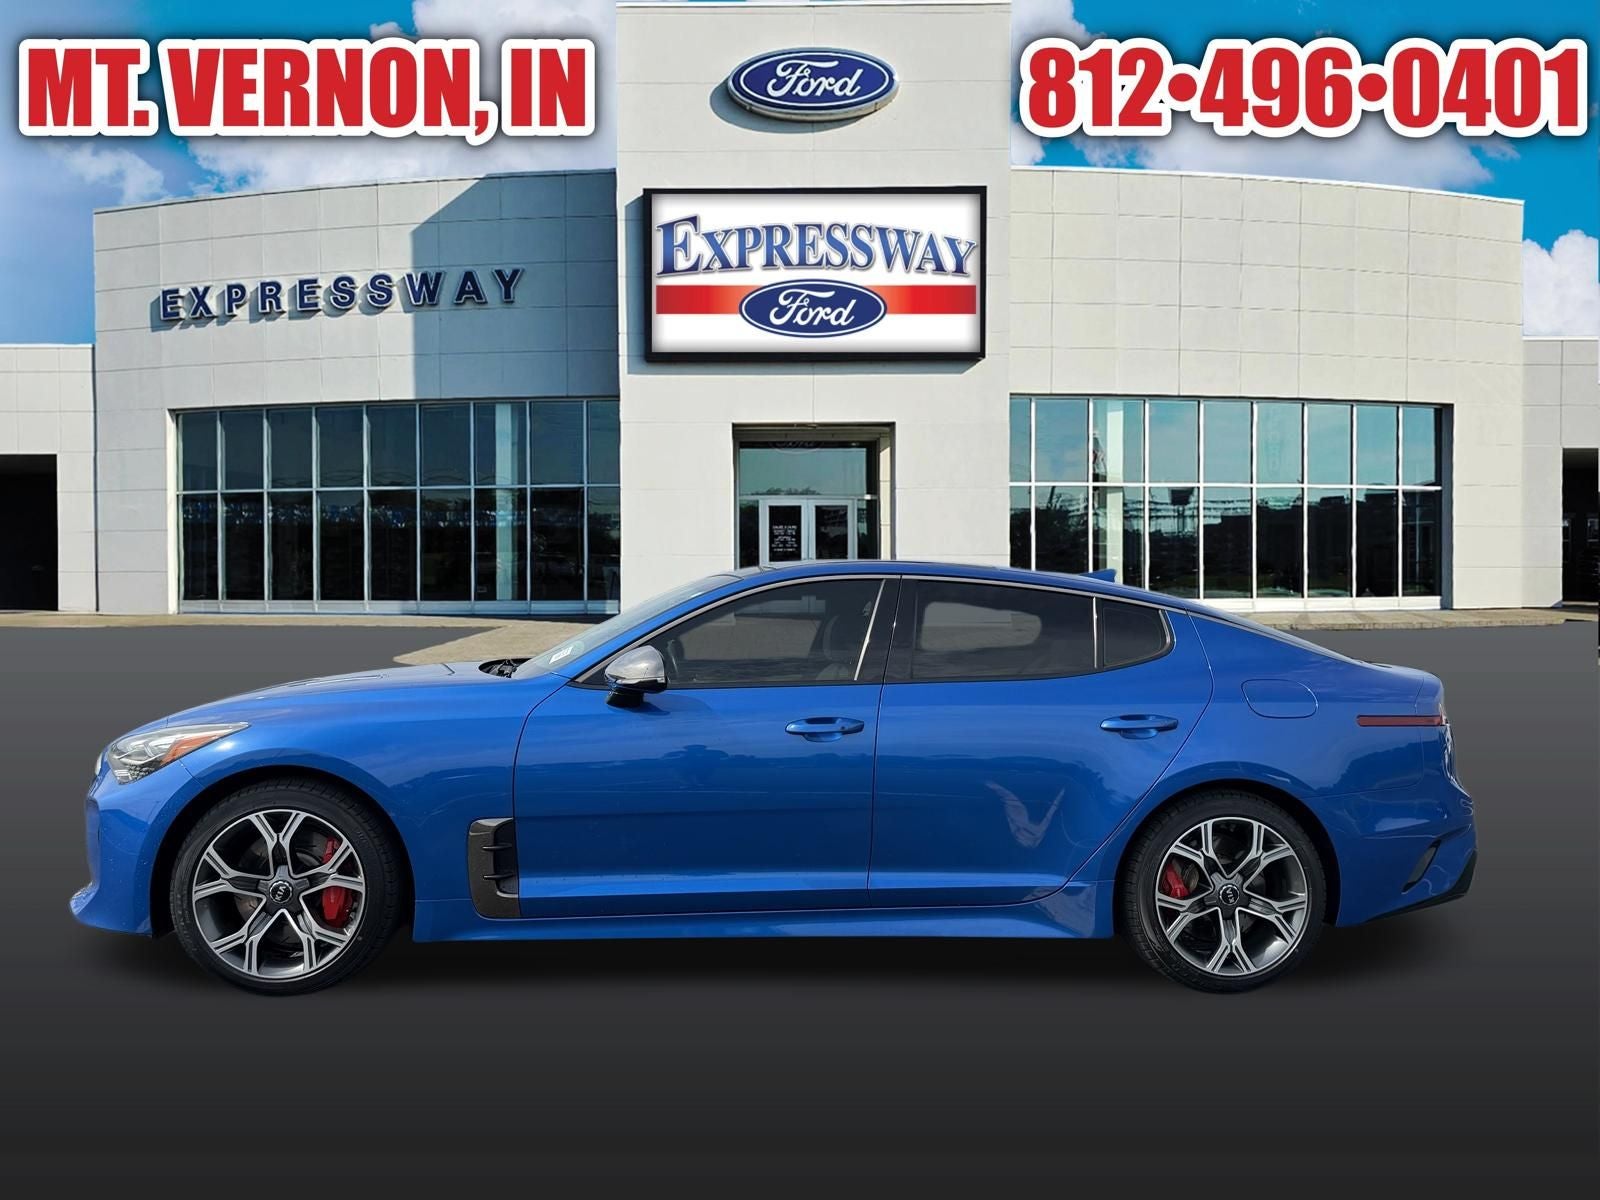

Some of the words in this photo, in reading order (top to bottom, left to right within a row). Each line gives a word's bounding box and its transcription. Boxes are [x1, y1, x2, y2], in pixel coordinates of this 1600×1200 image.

[766, 60, 863, 97] Ford
[656, 215, 977, 276] EXPRESSWAY
[160, 268, 525, 321] EXPRESSWAY
[769, 289, 857, 326] Ford
